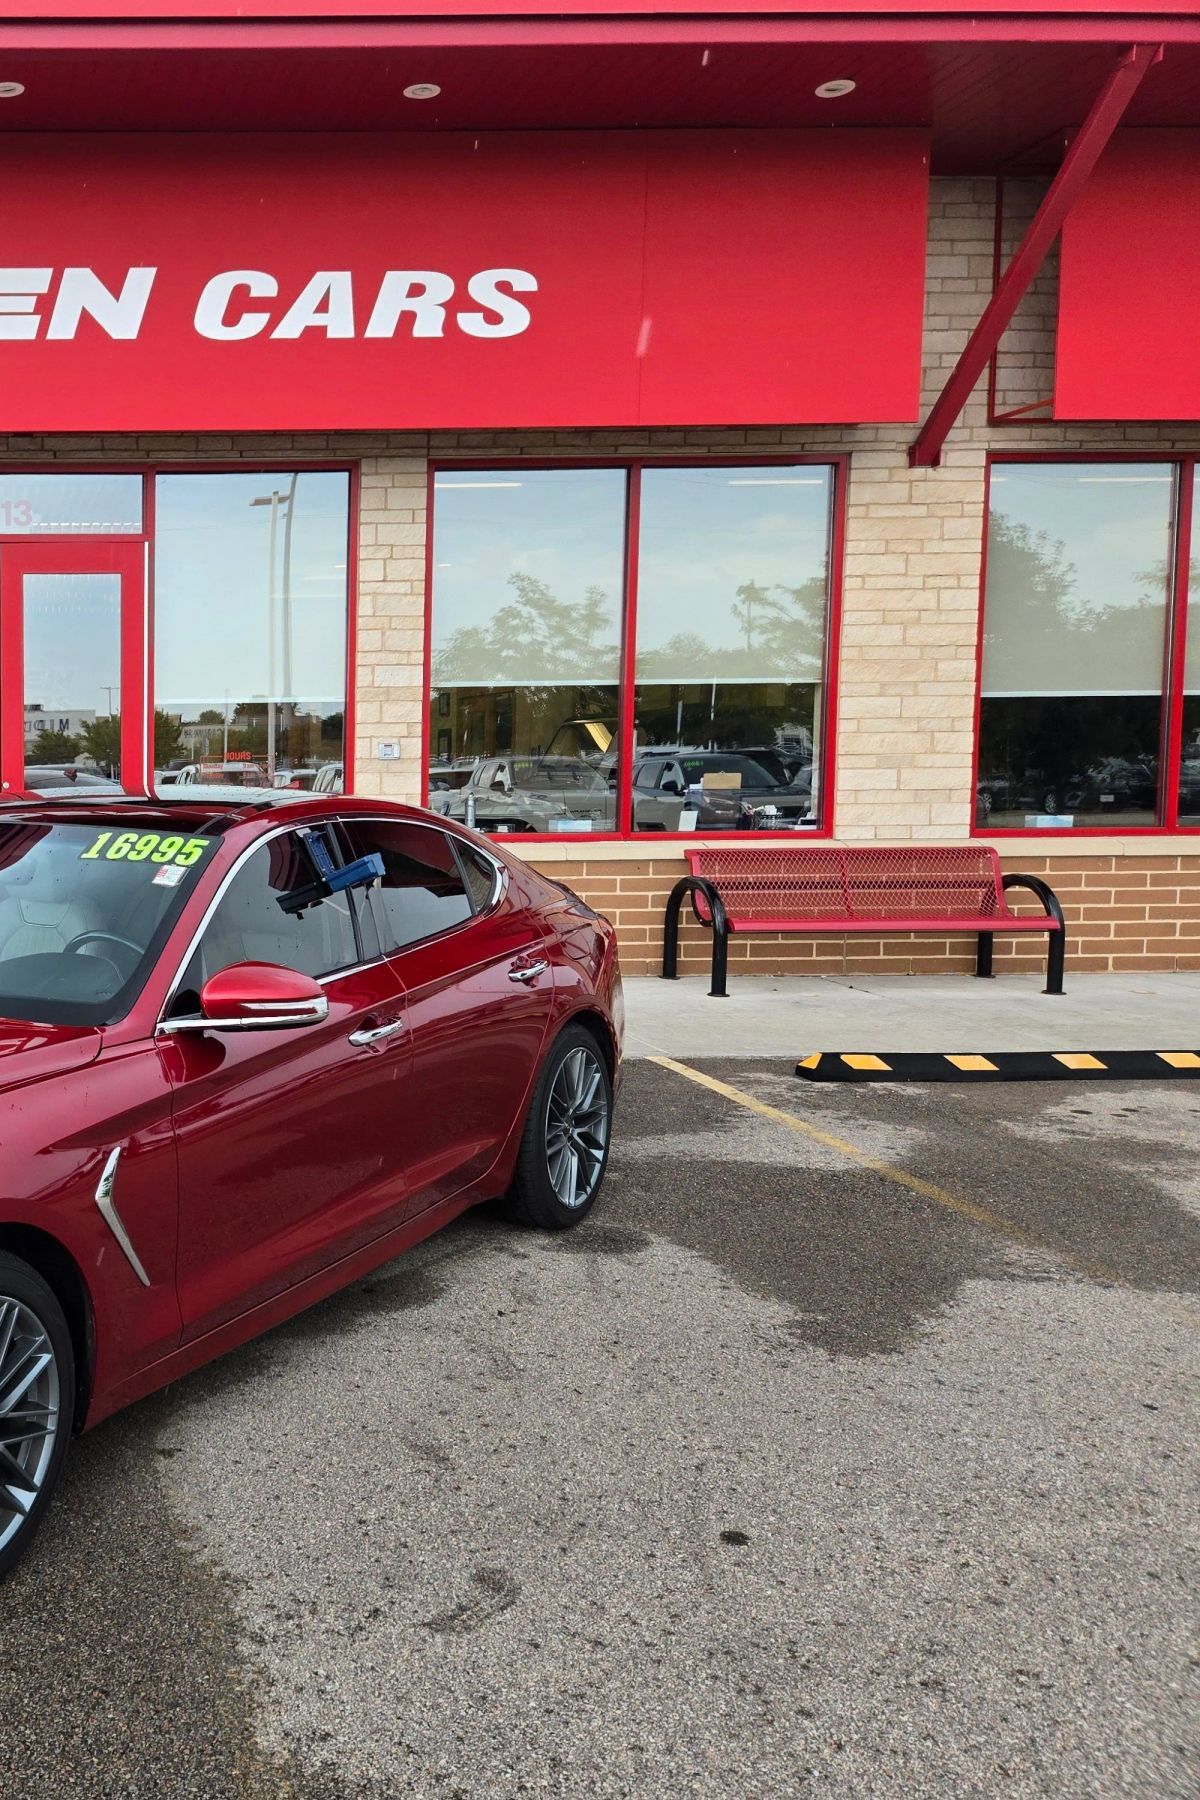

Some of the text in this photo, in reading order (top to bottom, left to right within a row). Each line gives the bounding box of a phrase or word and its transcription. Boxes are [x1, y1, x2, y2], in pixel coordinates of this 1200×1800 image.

[194, 268, 537, 340] CARS
[224, 751, 252, 761] HOURS
[80, 832, 210, 866] 16995
